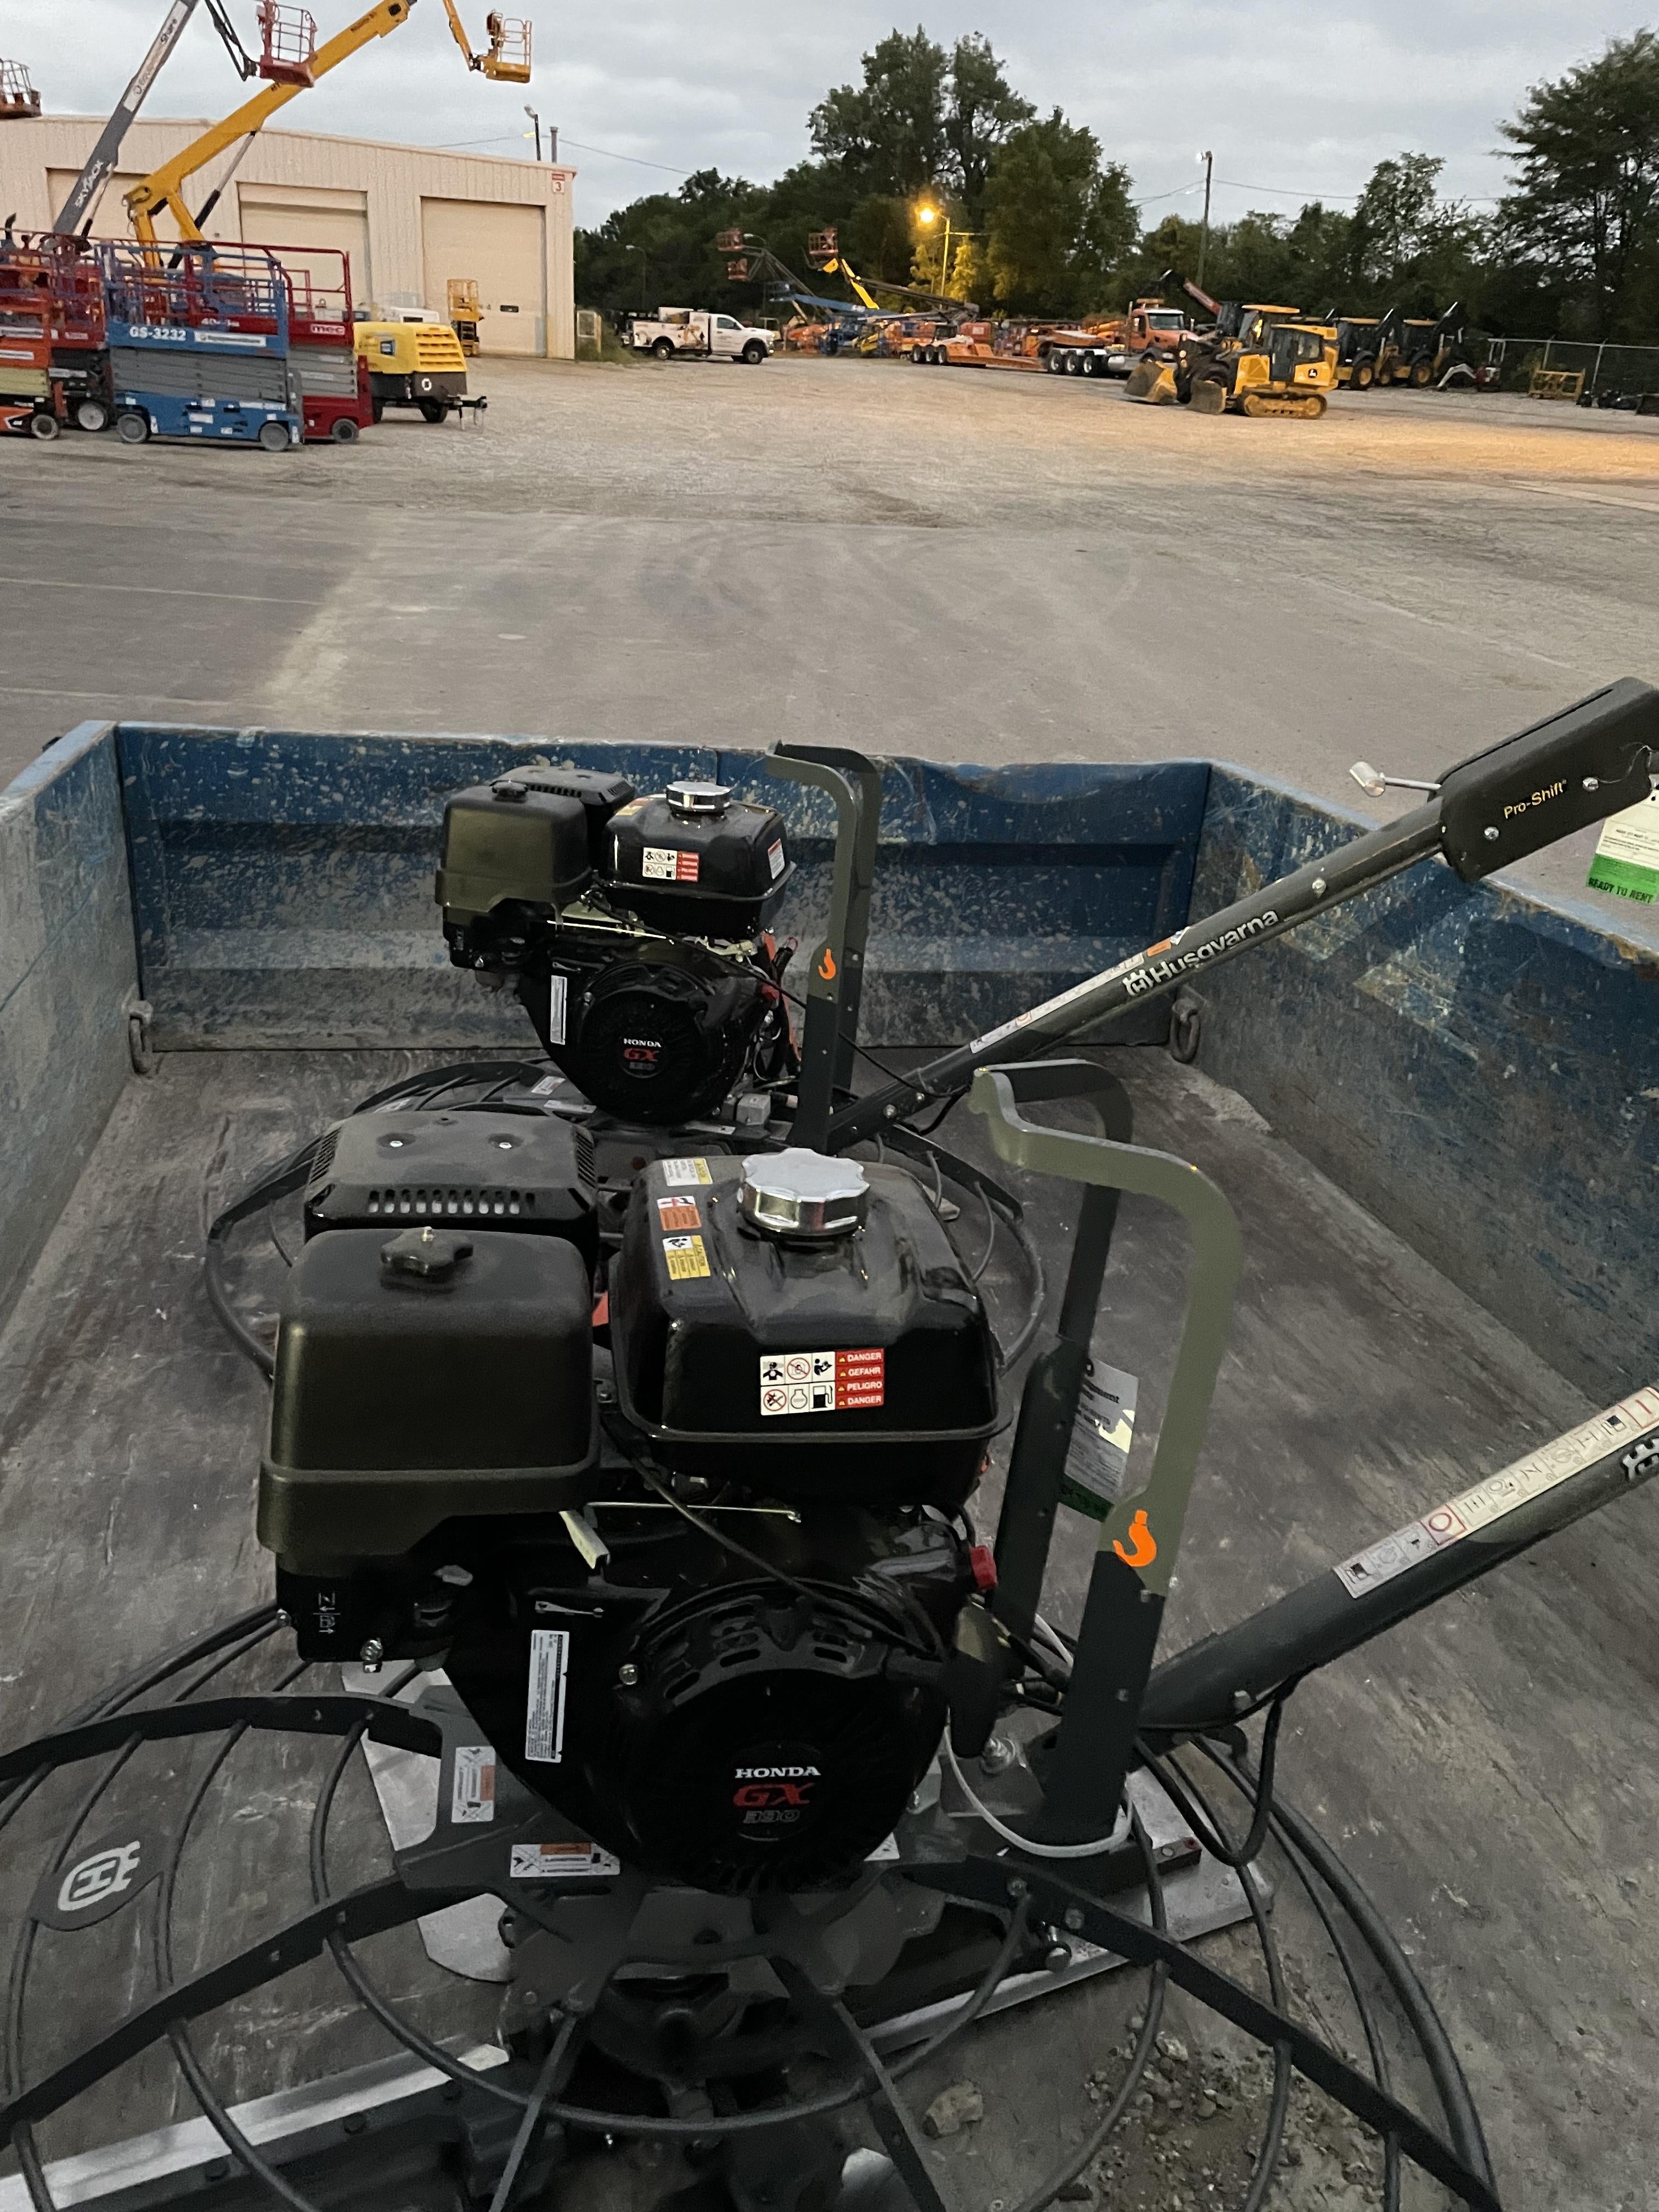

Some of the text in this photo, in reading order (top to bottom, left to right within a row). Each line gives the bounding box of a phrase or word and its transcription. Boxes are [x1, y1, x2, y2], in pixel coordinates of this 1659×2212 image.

[74, 159, 104, 208] SKYJACK
[555, 181, 562, 191] 3
[129, 326, 187, 341] GS-3232
[1503, 781, 1564, 820] Pro-Shift
[1588, 877, 1654, 904] READY TO RENT
[1149, 910, 1279, 984] Husqvarna
[623, 1038, 662, 1048] HONDA
[624, 1048, 660, 1062] GX
[847, 1352, 882, 1362] DANGER
[848, 1367, 881, 1377] GEFAHR
[847, 1381, 883, 1392] PELIGRO
[847, 1395, 882, 1405] DANGER
[735, 1766, 821, 1779] HONDA
[733, 1782, 816, 1807] GX
